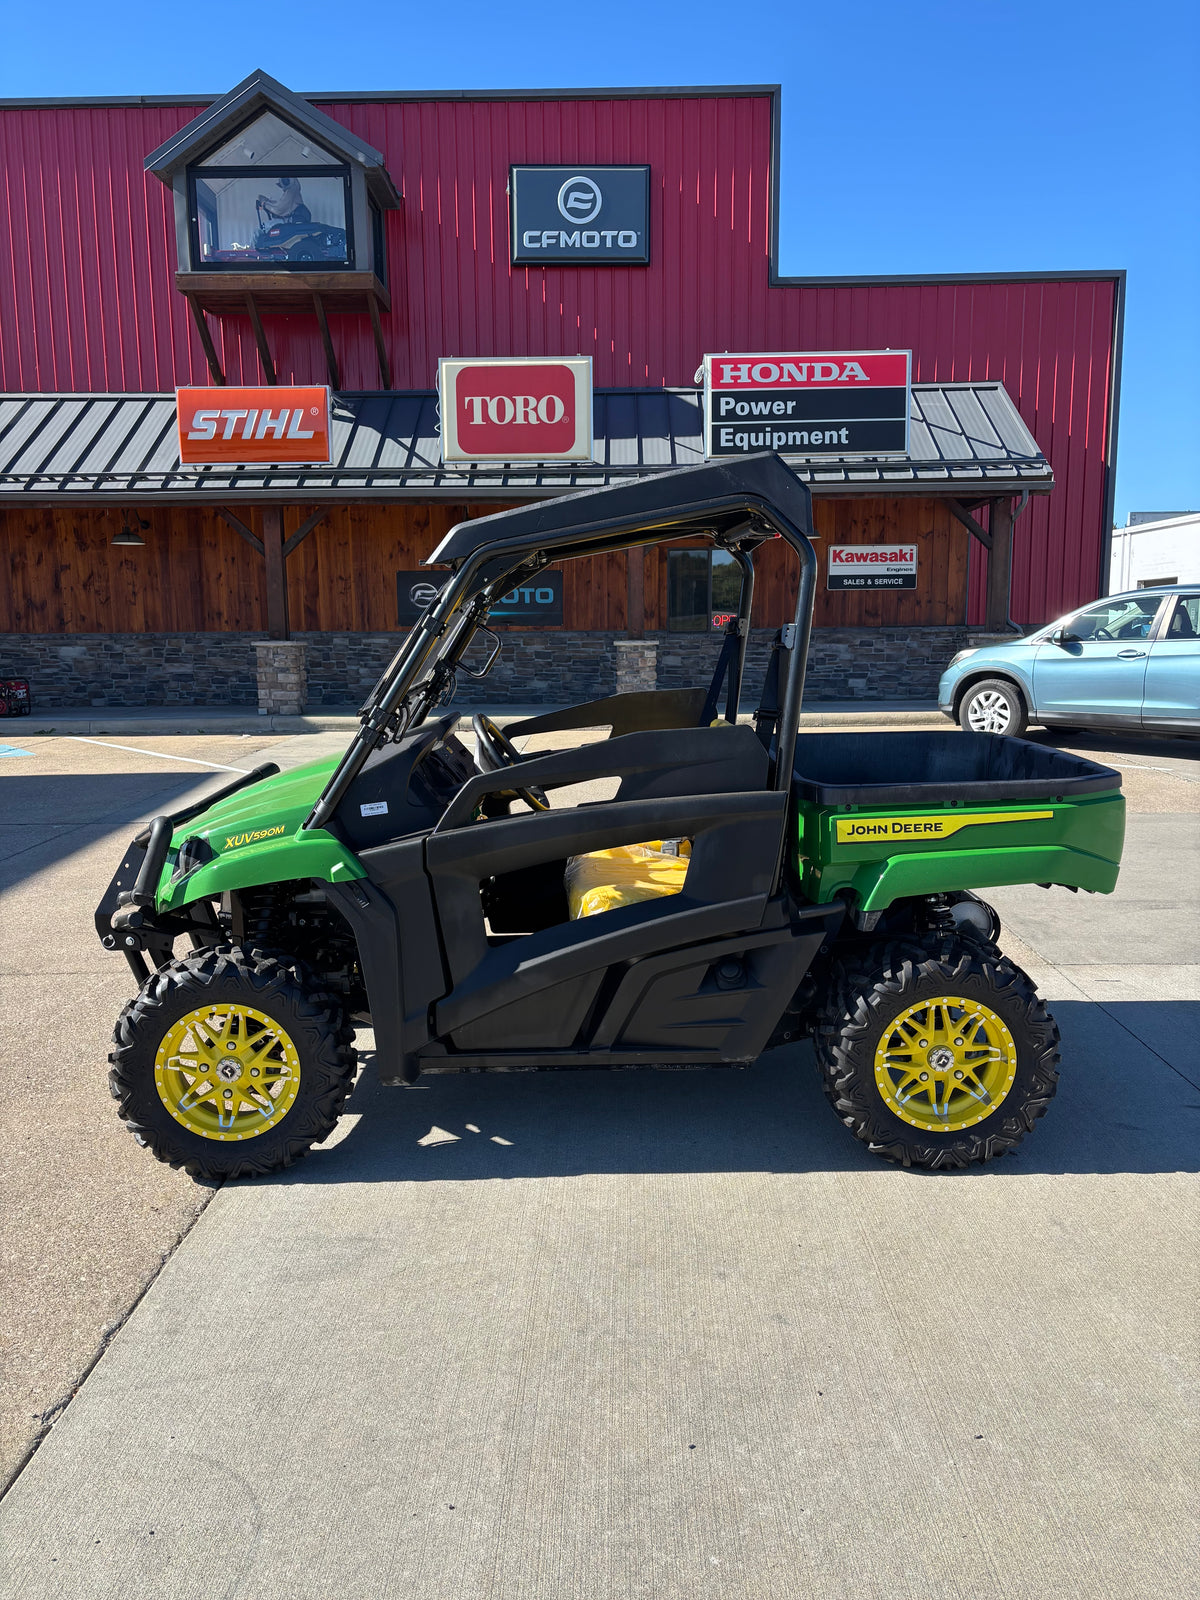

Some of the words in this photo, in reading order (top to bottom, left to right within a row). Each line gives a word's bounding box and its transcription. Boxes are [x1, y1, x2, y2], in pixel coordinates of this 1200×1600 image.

[523, 230, 637, 248] CFMOTO
[719, 362, 870, 383] HONDA
[464, 394, 565, 425] TORO
[720, 397, 796, 416] Power
[187, 408, 315, 440] STIHL
[720, 427, 849, 450] Equipment
[832, 548, 914, 563] Kawasaki
[223, 825, 285, 849] XUV590M
